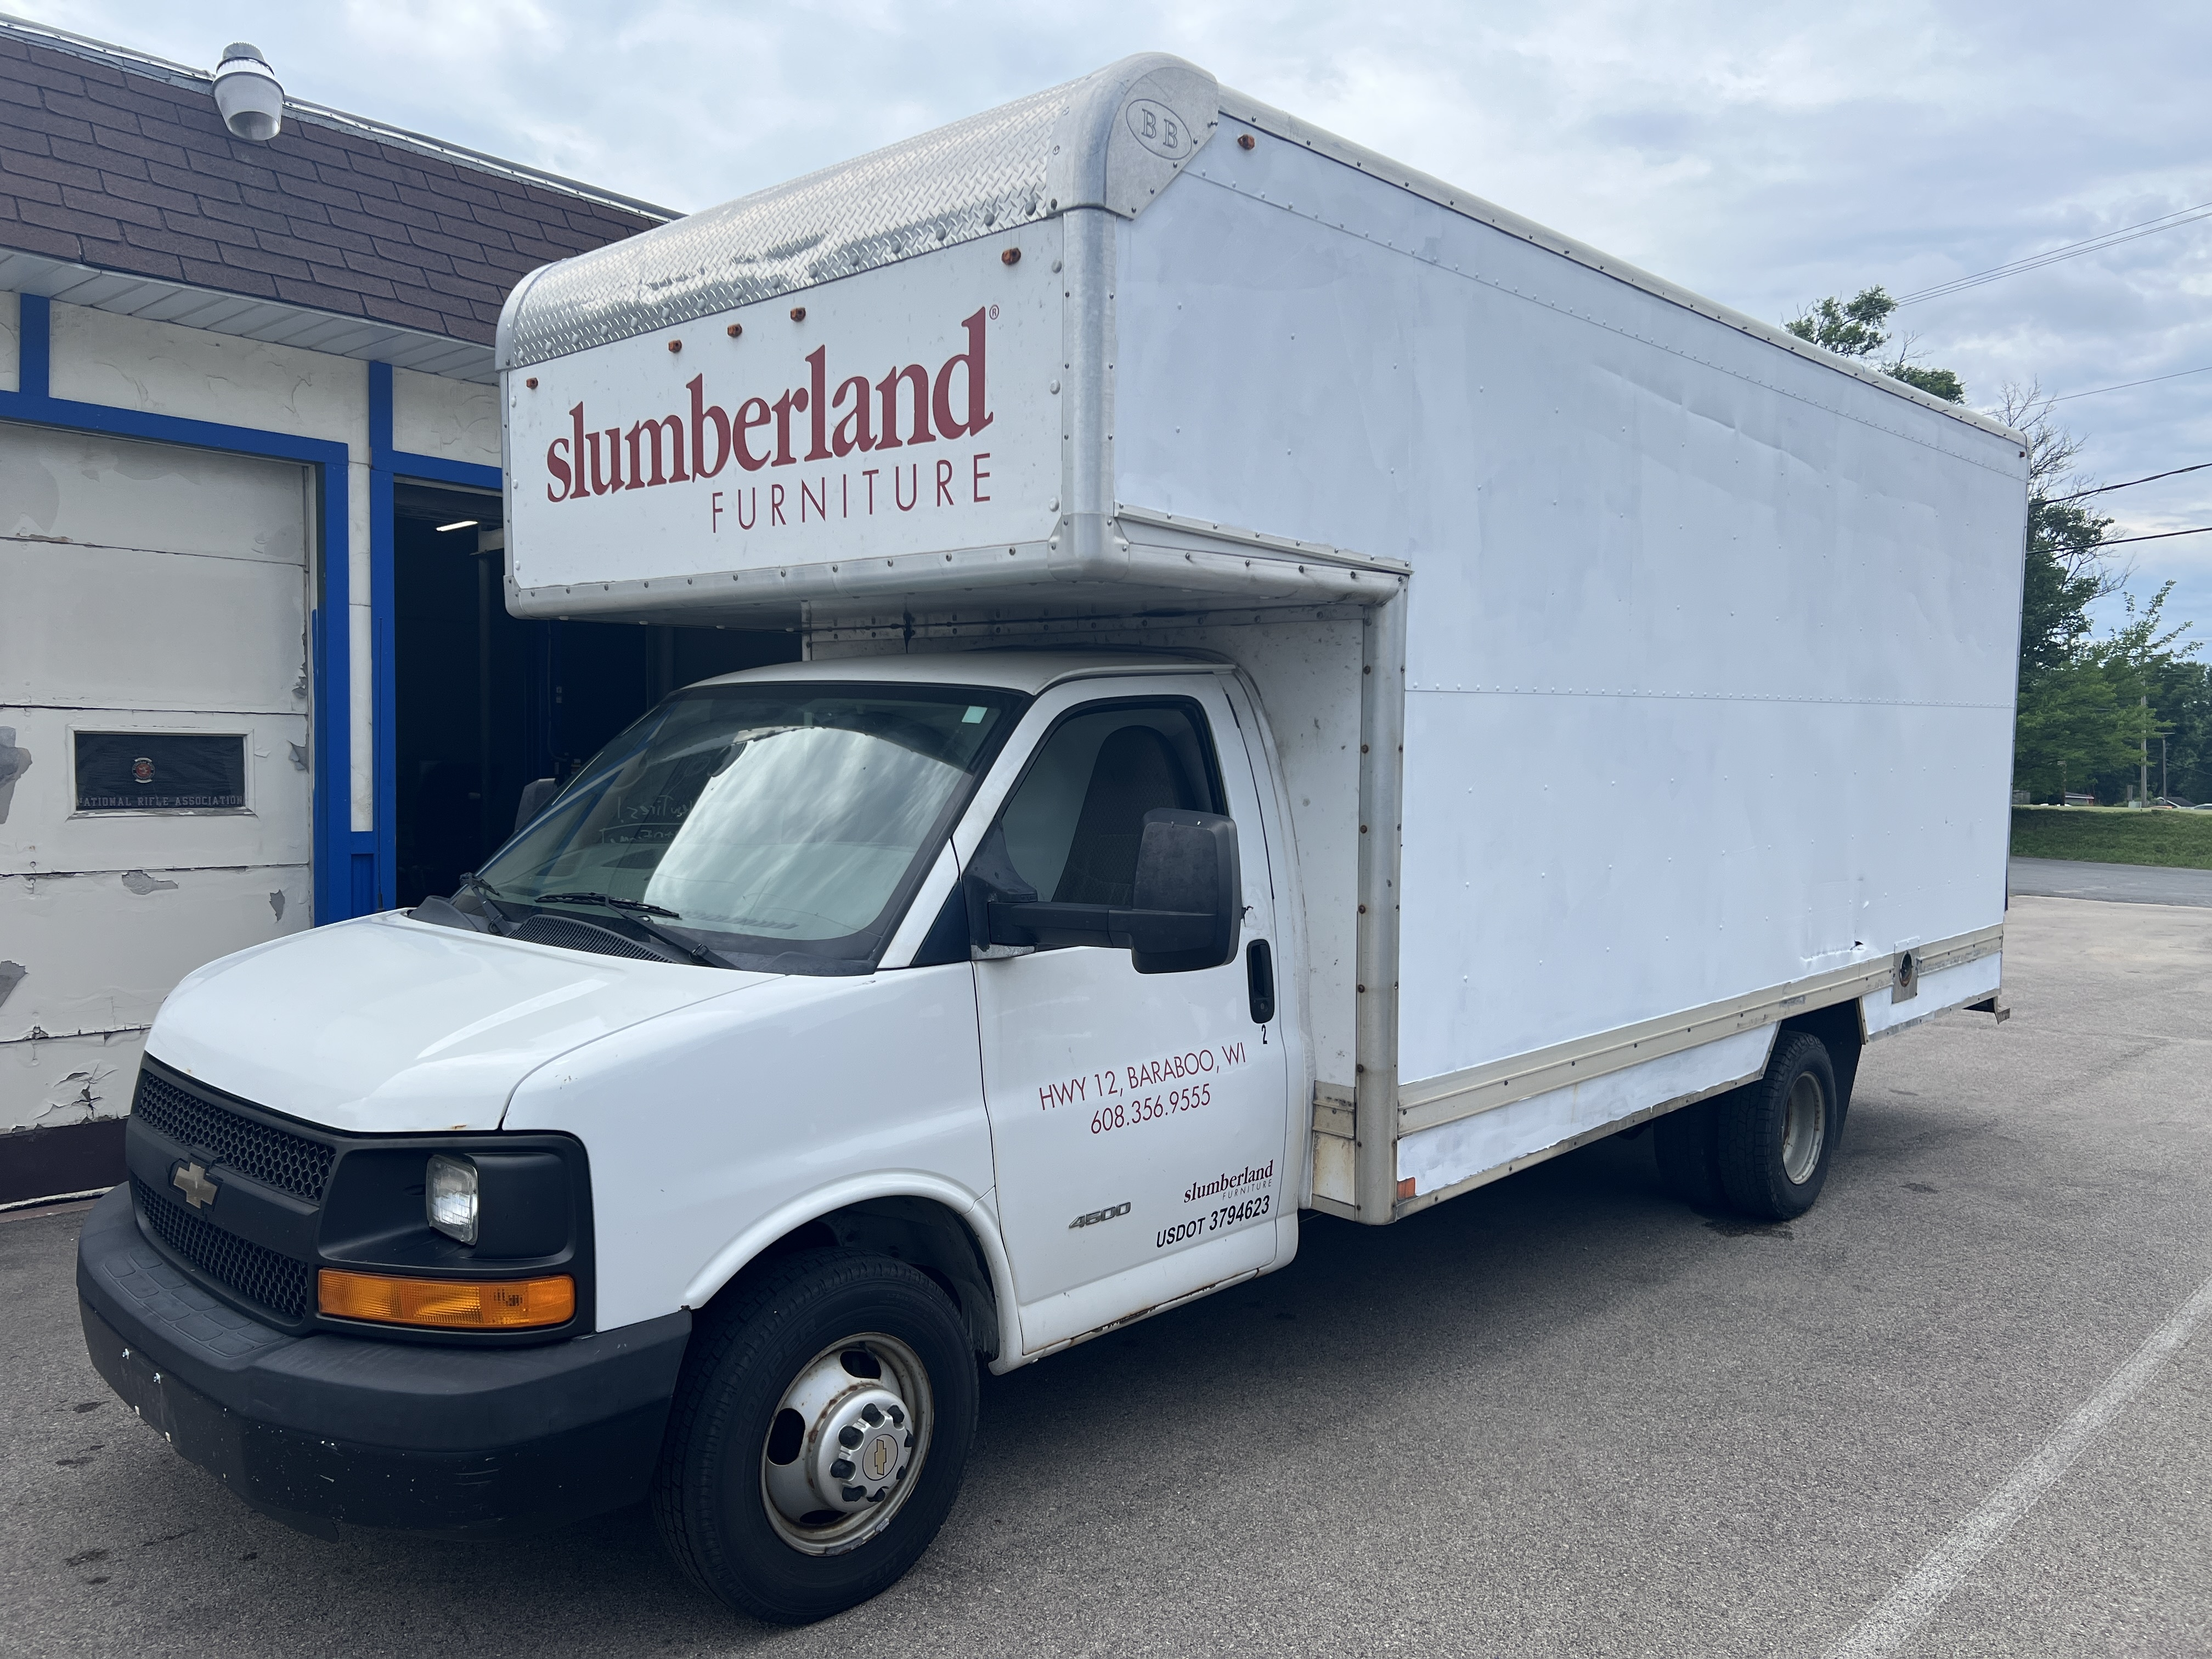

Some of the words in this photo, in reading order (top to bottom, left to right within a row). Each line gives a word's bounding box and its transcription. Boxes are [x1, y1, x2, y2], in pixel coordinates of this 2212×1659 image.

[546, 306, 994, 503] slumberland
[712, 453, 991, 534] FURNITURE
[137, 796, 168, 806] RIFLE
[174, 795, 244, 806] ASSOCIATION
[1261, 1024, 1268, 1045] 2
[1039, 1076, 1086, 1111] HWY
[1094, 1070, 1124, 1097] 12,
[1127, 1049, 1220, 1090] BARABOO,
[1221, 1041, 1246, 1066] WI
[1091, 1083, 1211, 1135] 608.356.9555
[1183, 1159, 1274, 1203] slumberland
[1222, 1178, 1272, 1201] FURNITURE
[1068, 1201, 1132, 1229] 4500
[1156, 1217, 1206, 1248] USDOT
[1209, 1194, 1270, 1231] 3794623
